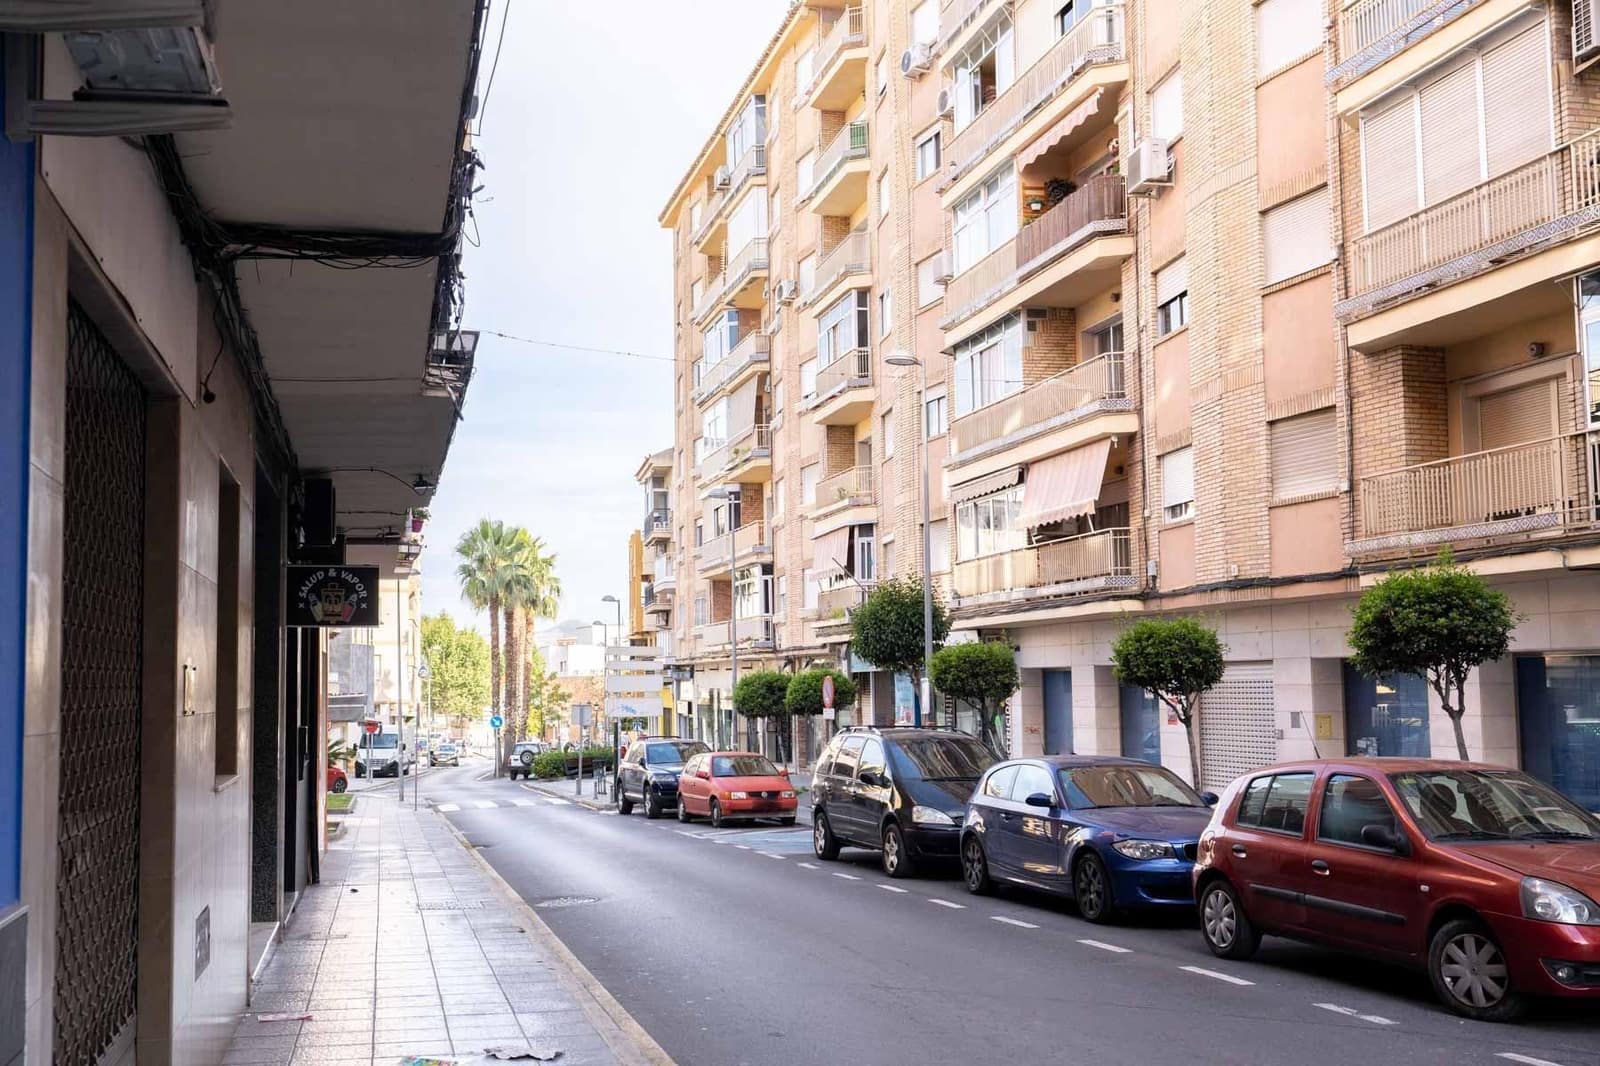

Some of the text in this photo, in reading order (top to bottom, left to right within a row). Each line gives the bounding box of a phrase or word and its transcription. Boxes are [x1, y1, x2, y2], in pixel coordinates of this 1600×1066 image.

[298, 568, 368, 599] SALUD & VAPOR
